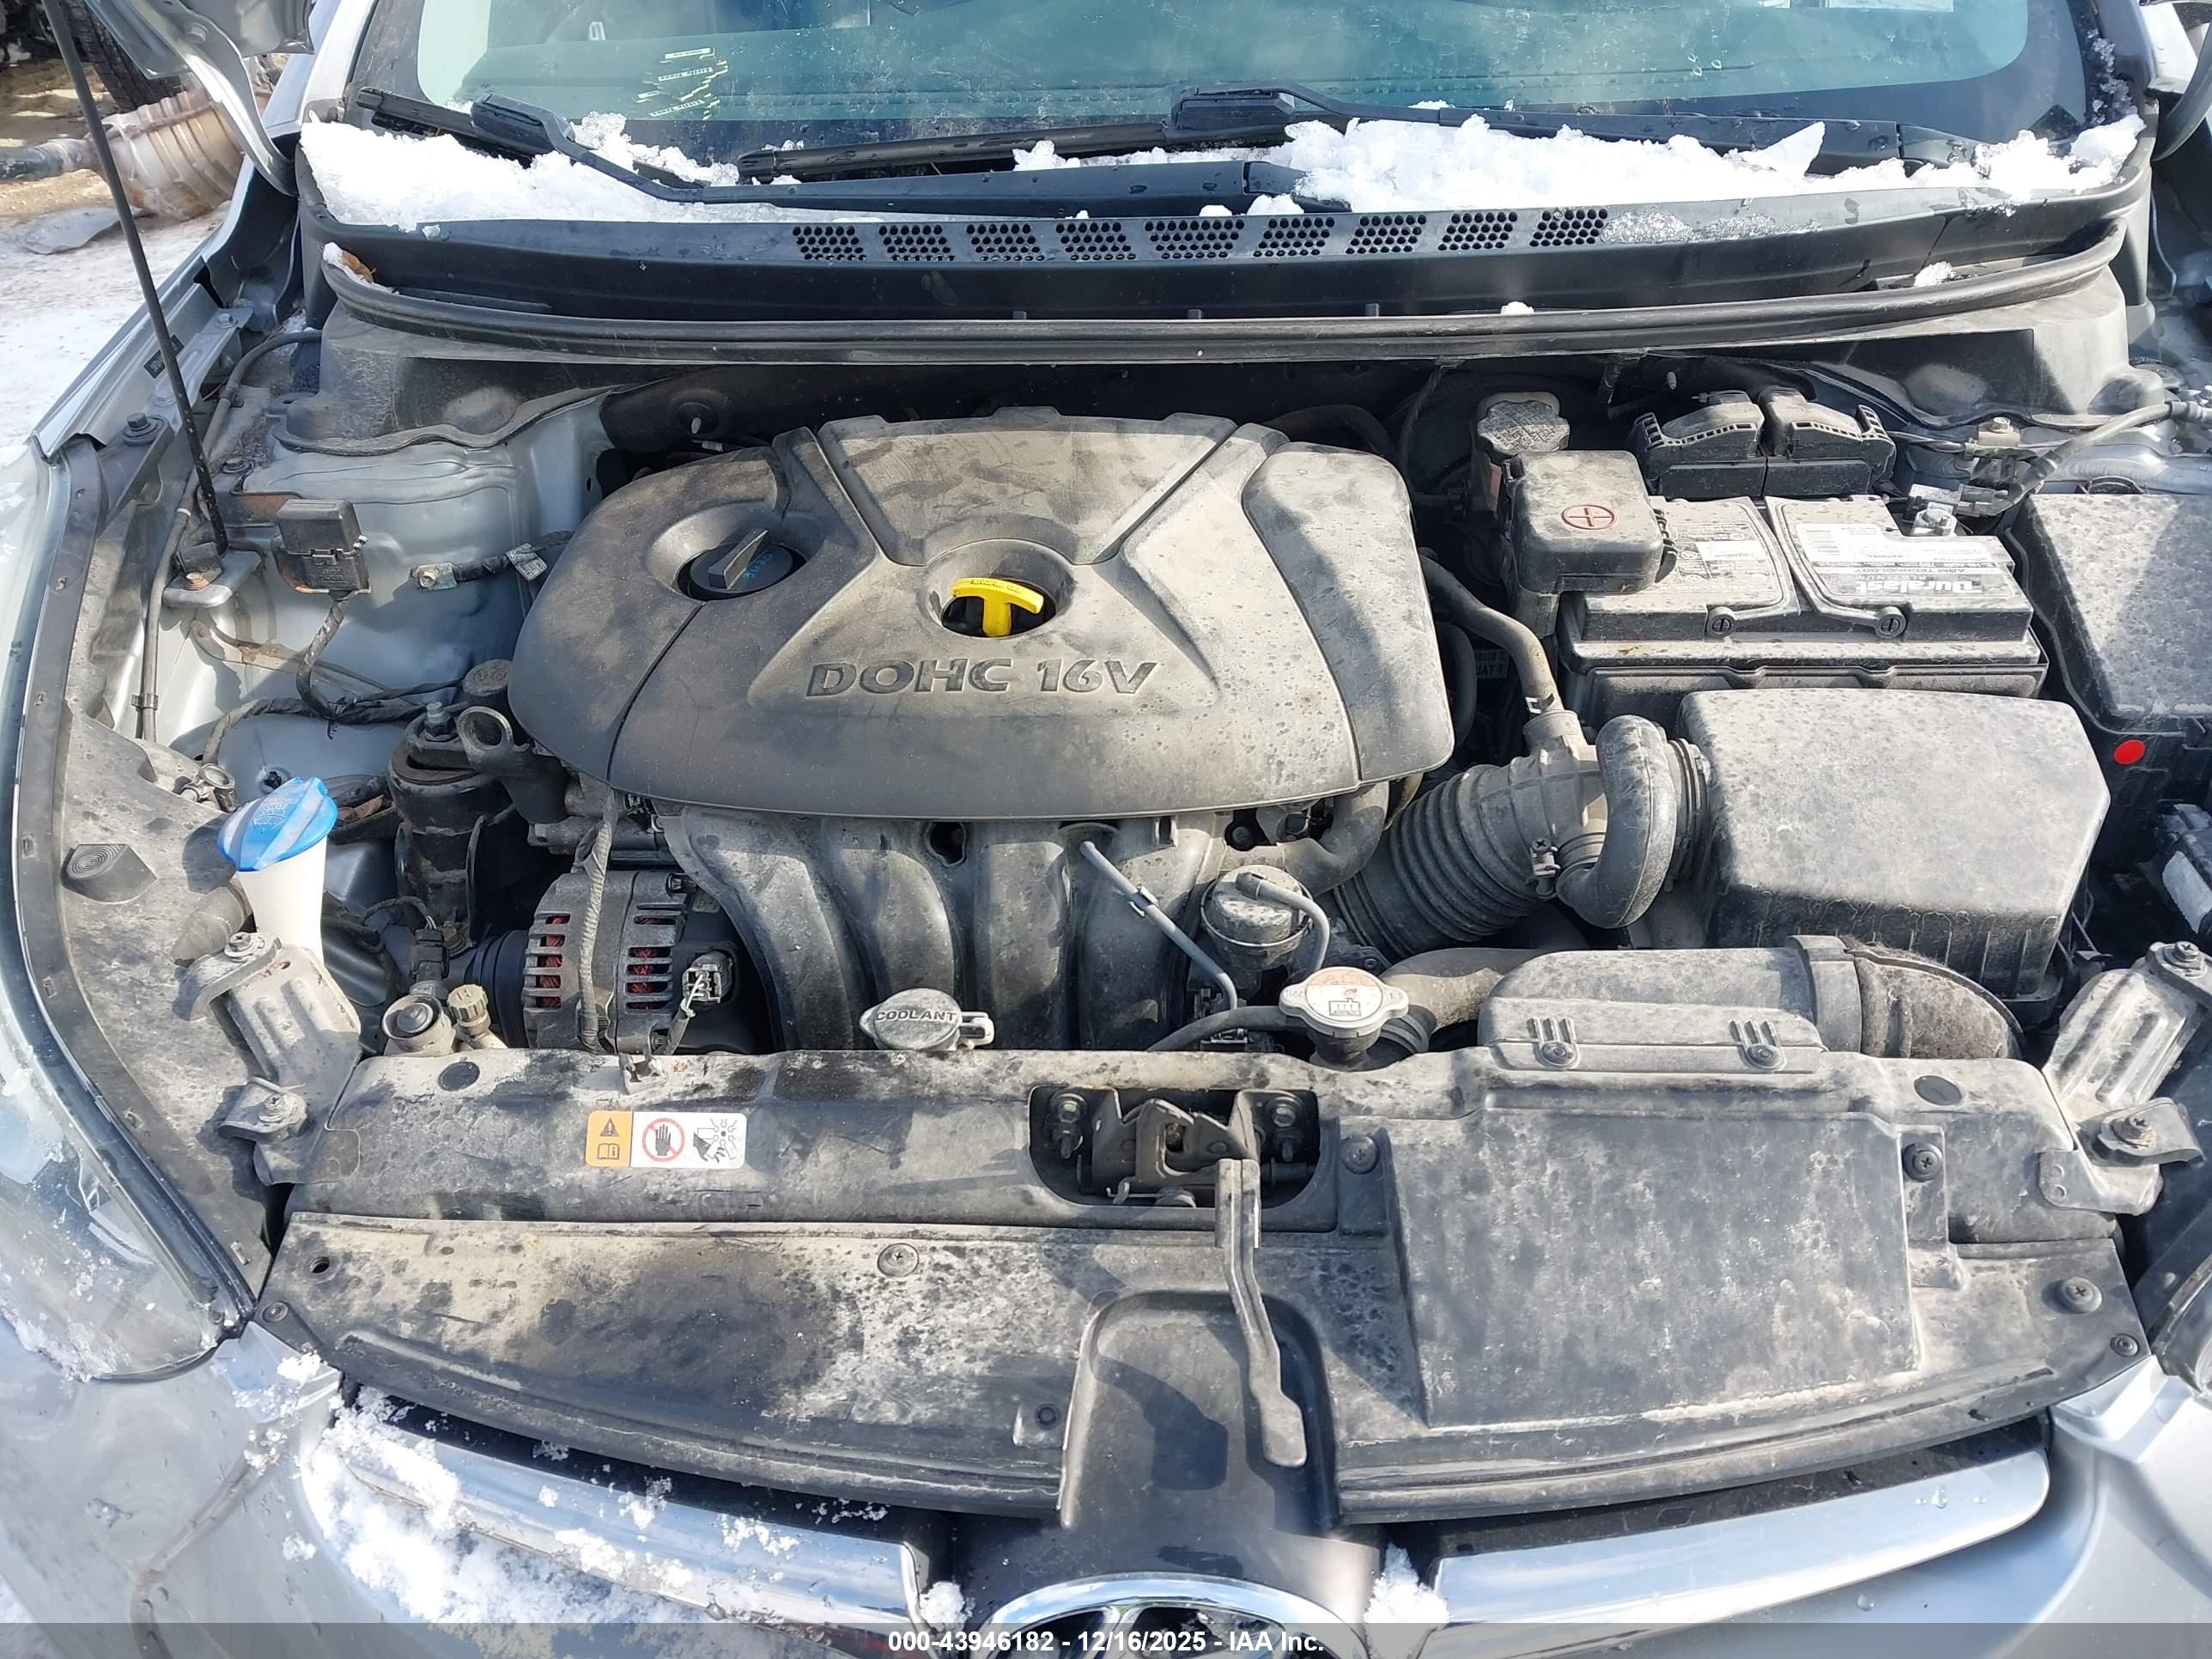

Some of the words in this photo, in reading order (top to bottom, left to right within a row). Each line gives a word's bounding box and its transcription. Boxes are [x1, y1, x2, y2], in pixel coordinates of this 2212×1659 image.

[1855, 580, 1983, 594] Duralast
[805, 658, 1013, 697] DOHC
[1037, 659, 1158, 695] 16V
[875, 1009, 957, 1022] COOLANT
